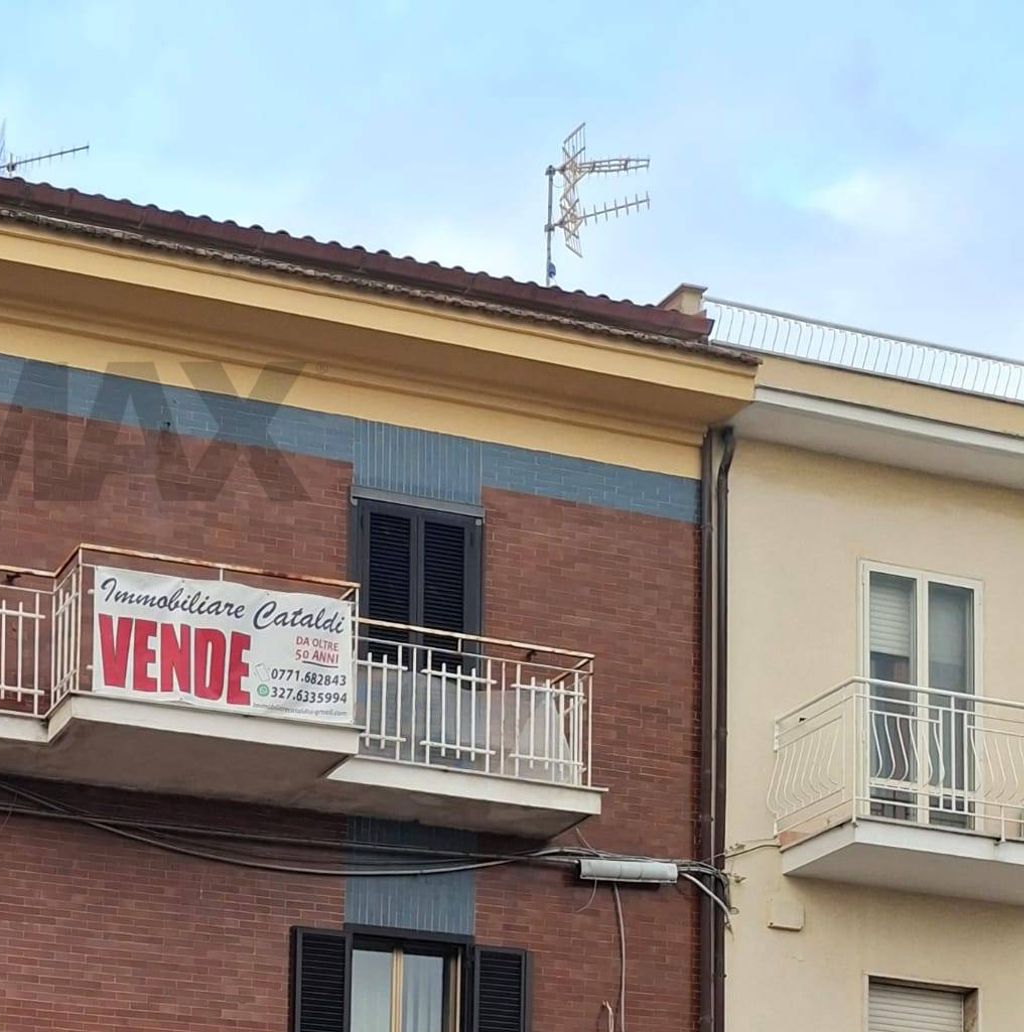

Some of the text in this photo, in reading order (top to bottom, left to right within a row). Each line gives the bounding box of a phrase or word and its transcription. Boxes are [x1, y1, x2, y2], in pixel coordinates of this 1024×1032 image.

[100, 577, 345, 634] Immobiliare Cataldi
[295, 636, 339, 651] DA OLTRE
[98, 613, 251, 706] VENDE
[295, 650, 339, 663] 50 ANNI
[271, 668, 347, 686] 0771.682843
[271, 687, 347, 704] 327.6335994
